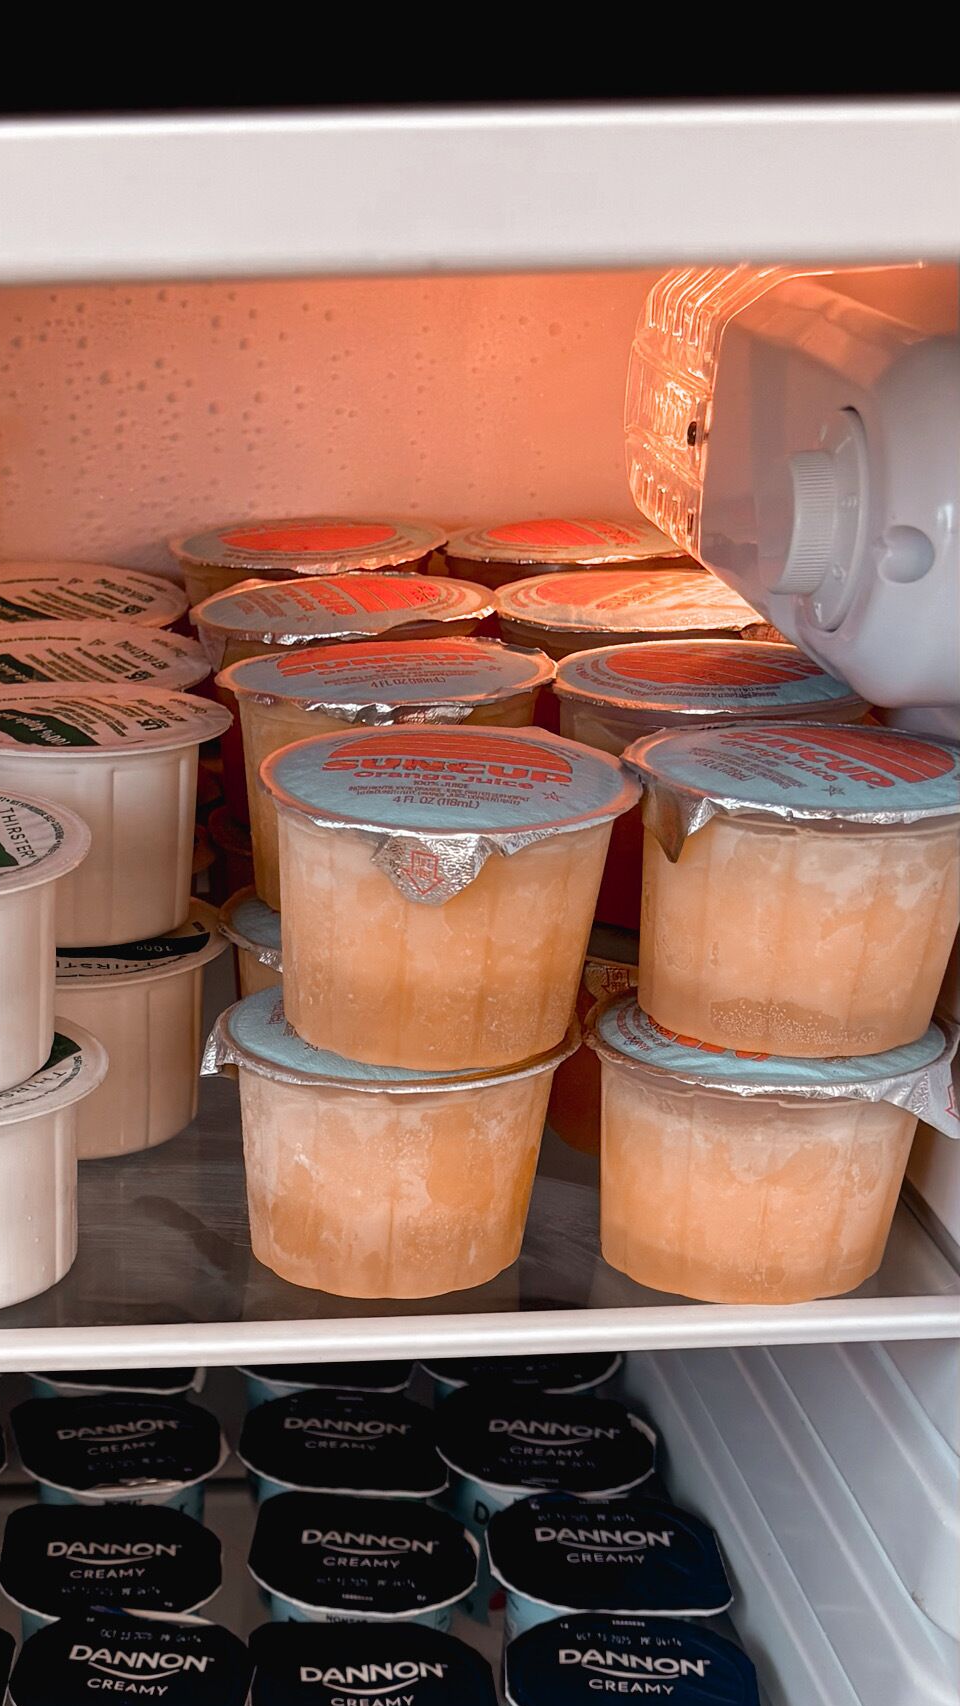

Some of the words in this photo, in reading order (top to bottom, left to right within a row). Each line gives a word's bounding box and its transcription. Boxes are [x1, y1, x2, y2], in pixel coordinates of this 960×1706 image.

[719, 732, 896, 787] SUNCUP
[322, 758, 573, 785] SUNCUP
[392, 796, 401, 804] 4
[403, 796, 418, 805] FL
[419, 796, 435, 806] OZ
[437, 798, 480, 810] (118mL)
[0, 807, 36, 857] THIRSTER
[56, 1420, 178, 1441] DANNON
[283, 1417, 407, 1435] DANNON
[488, 1418, 616, 1439] DANNON
[302, 1529, 434, 1555] DANNON
[535, 1526, 671, 1547] DANNON
[47, 1541, 178, 1556] DANNON
[567, 1552, 645, 1565] CREAMY
[323, 1556, 401, 1569] CREAMY
[70, 1568, 146, 1579] CREAMY
[69, 1644, 209, 1673] DANNON
[559, 1648, 706, 1678] DANNON
[300, 1661, 444, 1684] DANNON
[87, 1677, 168, 1697] CREAMY
[589, 1678, 674, 1696] CREAMY
